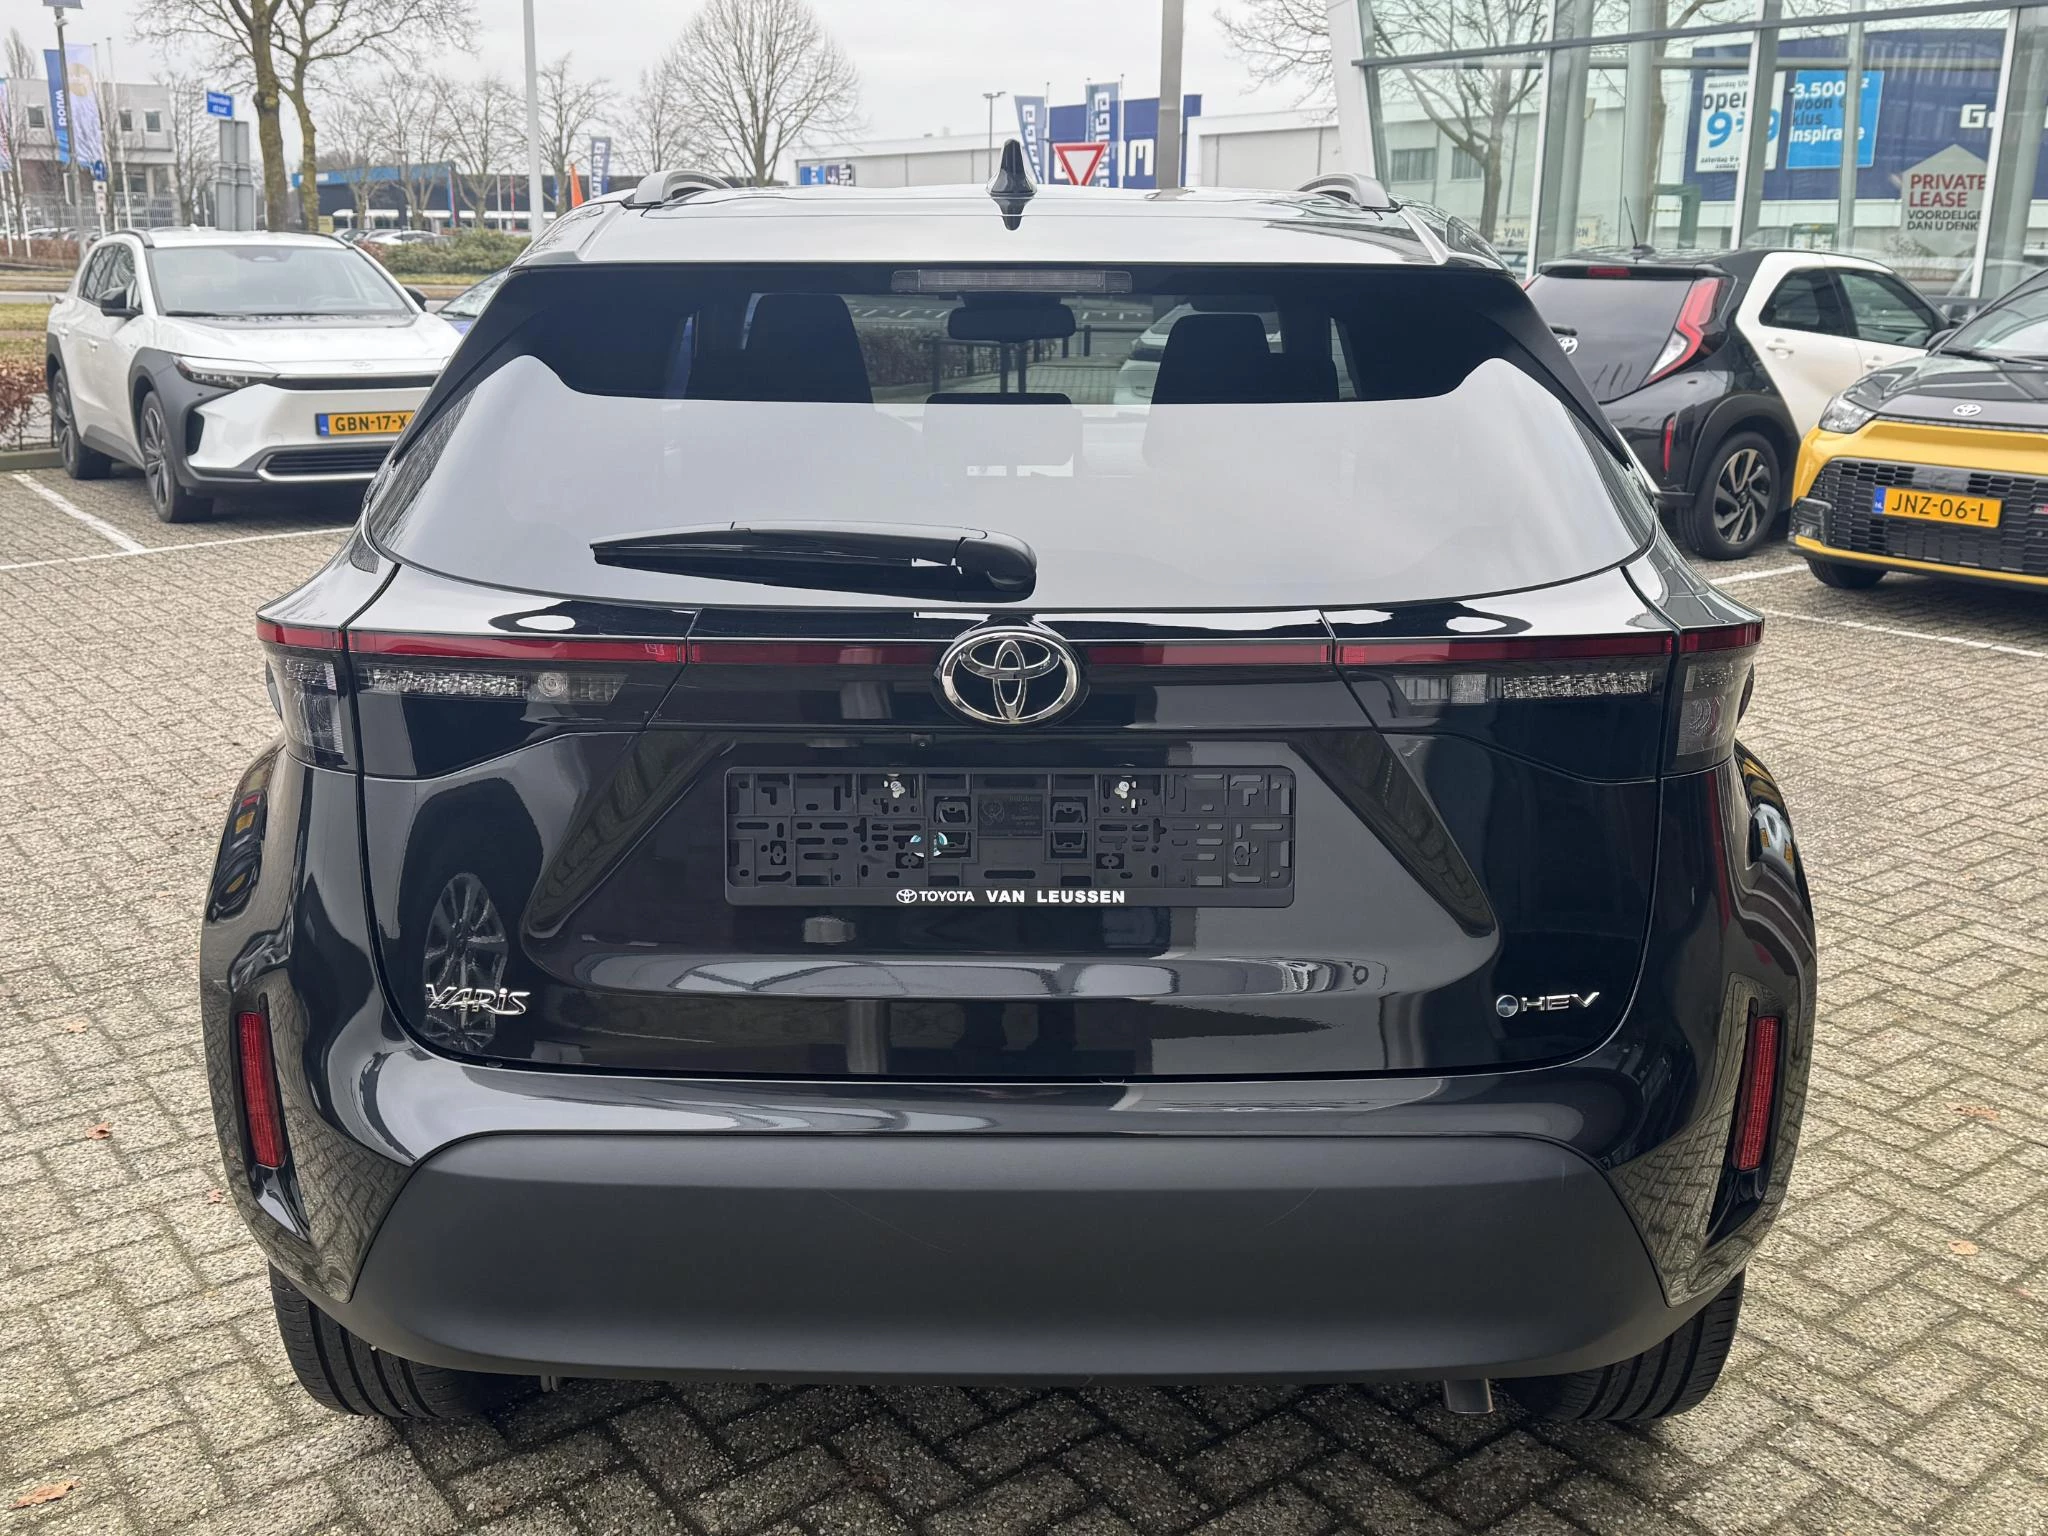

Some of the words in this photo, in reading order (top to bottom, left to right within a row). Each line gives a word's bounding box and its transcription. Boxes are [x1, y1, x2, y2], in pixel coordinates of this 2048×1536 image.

[1910, 174, 1986, 190] PRIVATE
[1909, 192, 1968, 207] LEASE
[1907, 221, 1933, 230] DAN
[1935, 221, 1944, 230] U
[335, 415, 406, 431] GBN-17-X
[1891, 493, 1989, 522] JNZ-06-L
[919, 890, 975, 902] TOYOTA
[986, 889, 1025, 903] VAN
[1036, 889, 1125, 903] LEUSSEN
[1521, 991, 1600, 1012] HEV
